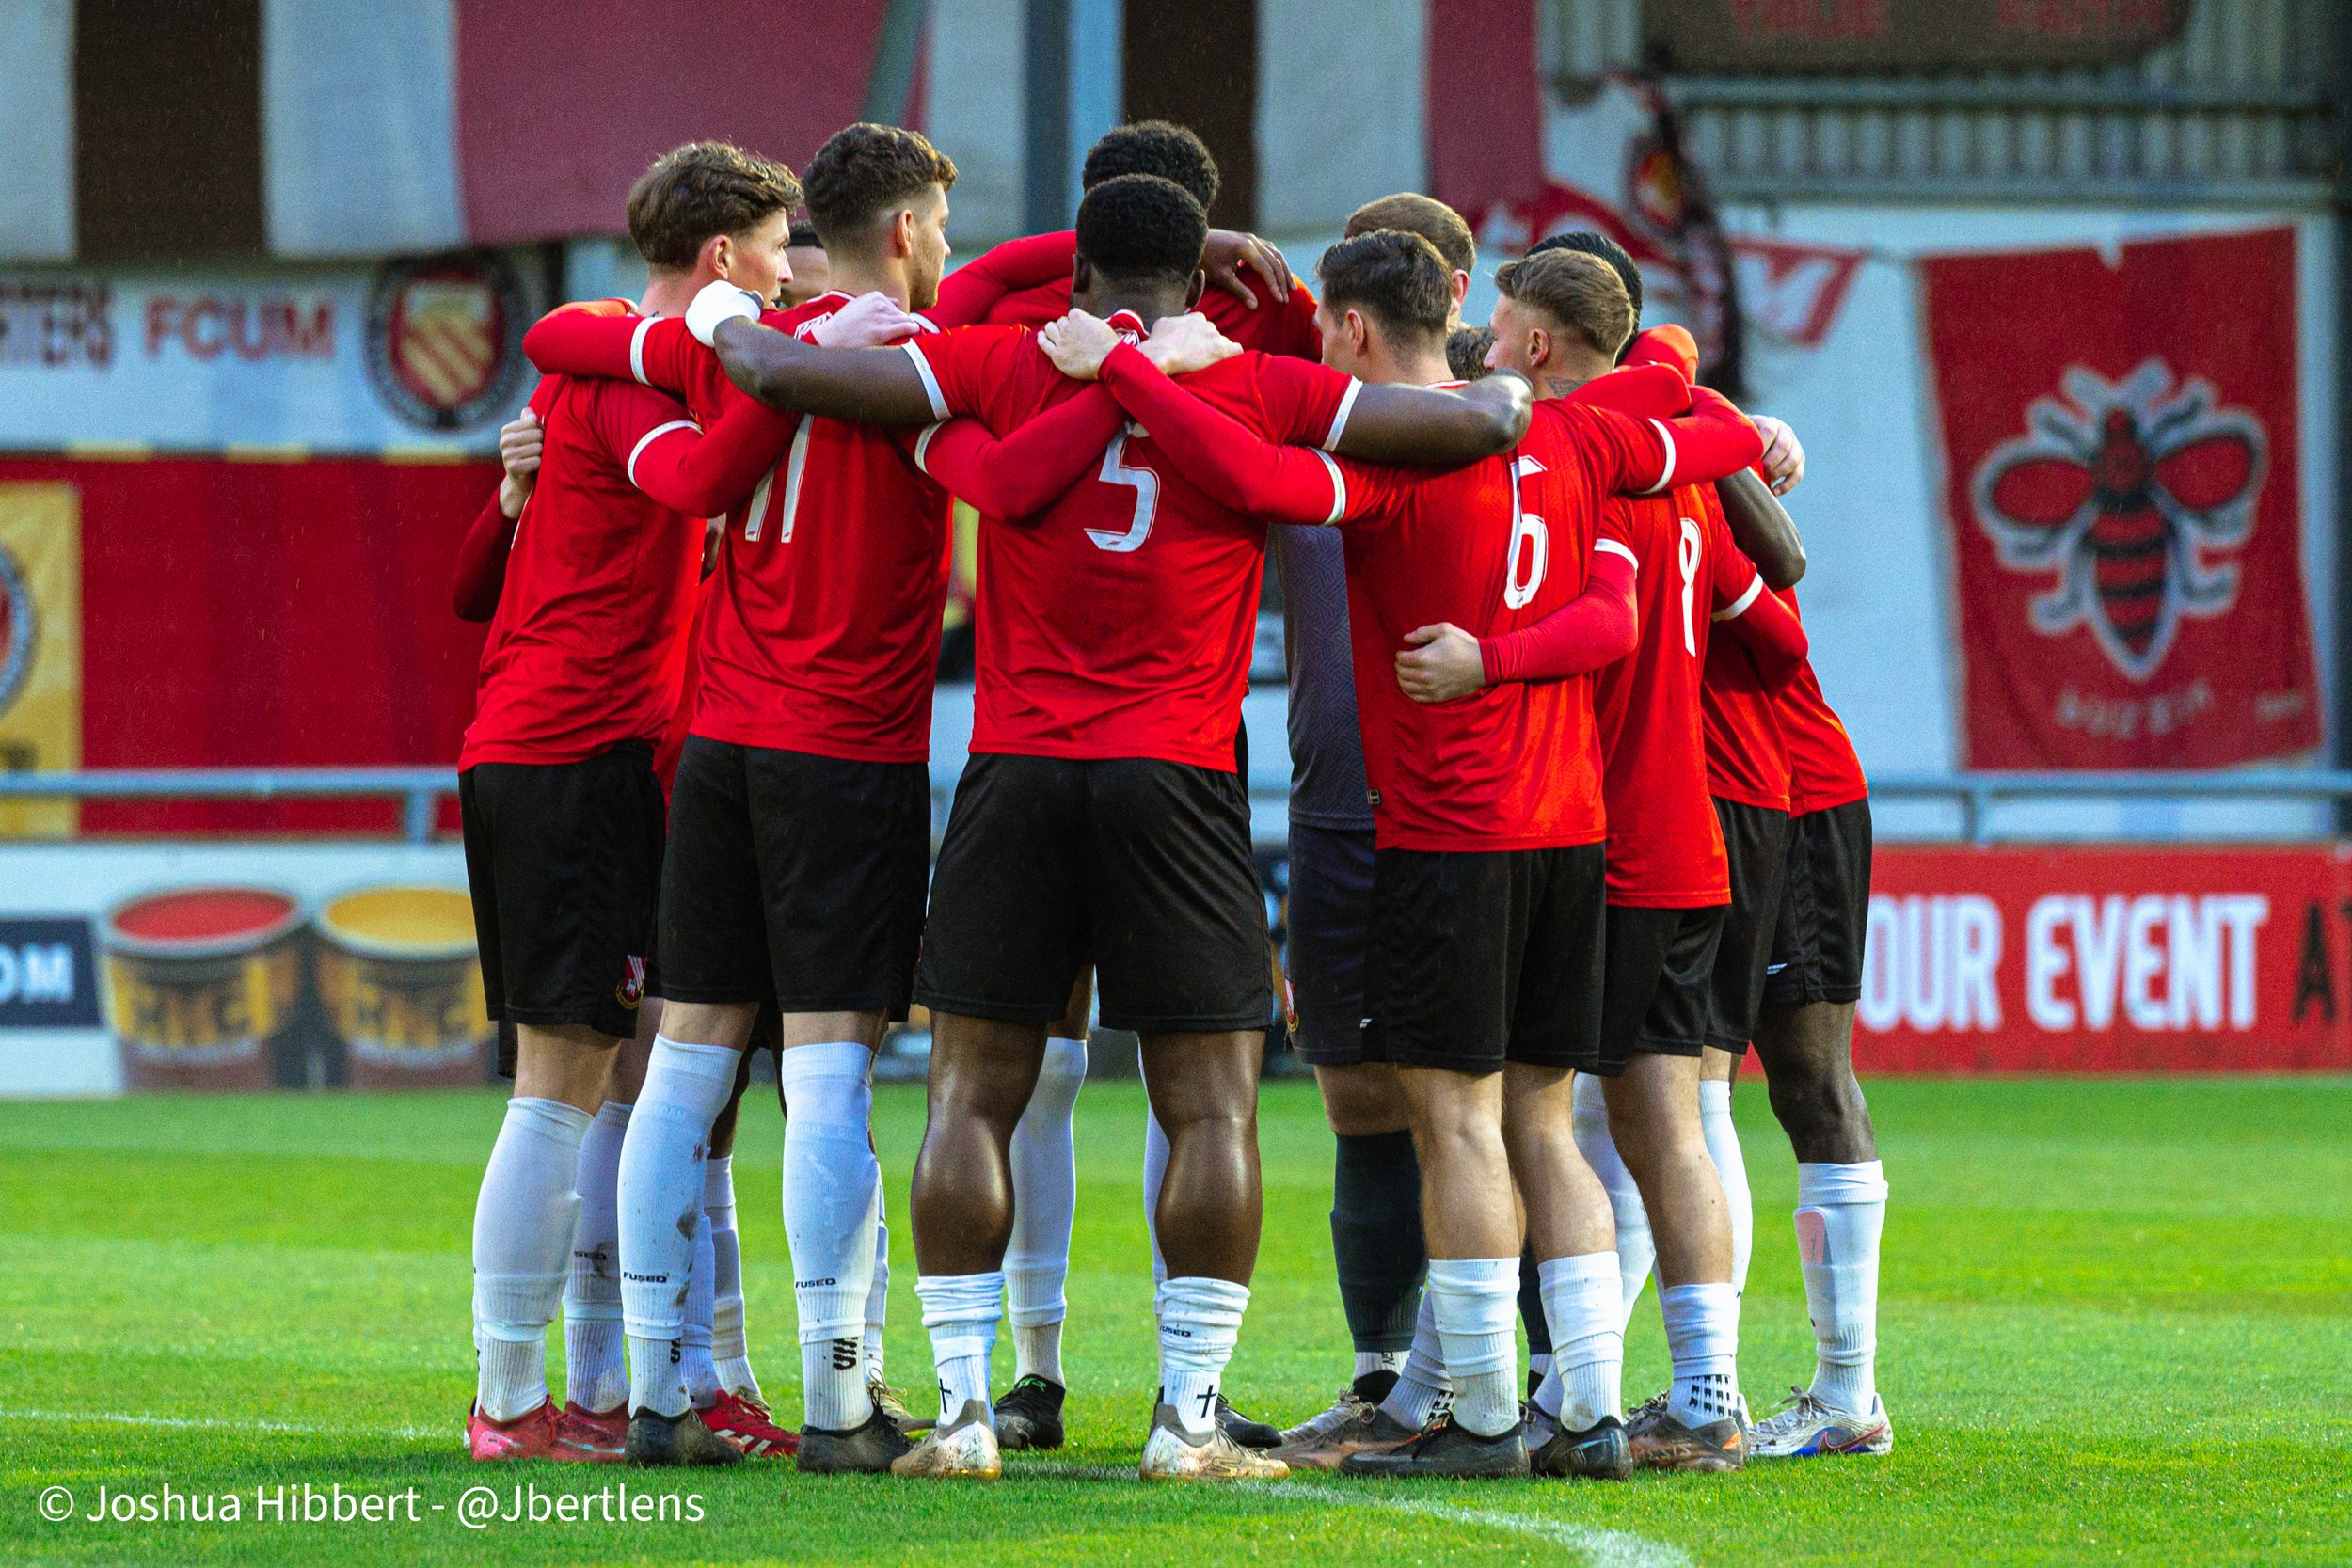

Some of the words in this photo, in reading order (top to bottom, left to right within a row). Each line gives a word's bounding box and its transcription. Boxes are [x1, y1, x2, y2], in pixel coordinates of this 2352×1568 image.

[143, 295, 335, 361] FCUM
[1083, 420, 1160, 553] 5
[1503, 454, 1549, 610] 6
[1679, 517, 1702, 657] 9
[2025, 894, 2269, 1032] EVENT
[623, 1271, 667, 1284] FUSED
[795, 1277, 836, 1289] FUSED
